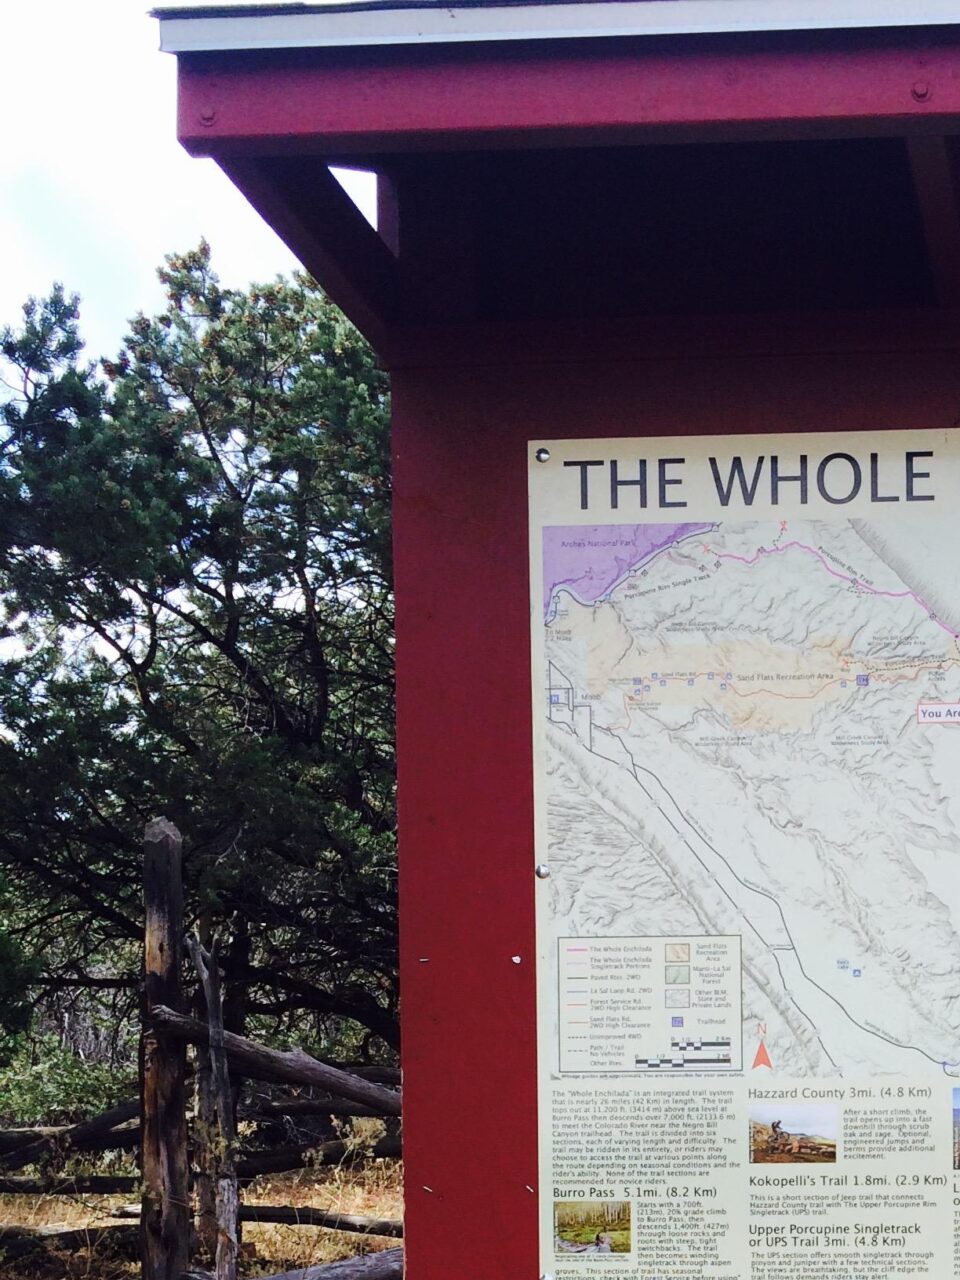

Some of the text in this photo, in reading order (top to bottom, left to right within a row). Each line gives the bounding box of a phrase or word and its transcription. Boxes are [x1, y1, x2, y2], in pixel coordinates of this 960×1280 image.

[563, 457, 688, 510] THE
[708, 451, 935, 507] WHOLE
[921, 709, 943, 719] You
[757, 1023, 767, 1035] N
[748, 1087, 932, 1101] Hazzard County 3mi. (4.8 Km)
[842, 1122, 930, 1132] downhill through scrub
[551, 1161, 564, 1169] the
[565, 1161, 585, 1169] route
[586, 1161, 627, 1171] depending
[639, 1161, 671, 1169] seasonal
[671, 1160, 712, 1169] conditions
[712, 1160, 727, 1169] and
[728, 1160, 741, 1169] the
[551, 1176, 667, 1185] recommended for novice riders.
[749, 1174, 948, 1189] Kokopelli's Trail 1.8mi. (2.9 Km)
[552, 1187, 717, 1200] Burro Pass 5.1mi. (8.2 Km)
[748, 1200, 937, 1210] Hazzard County trail with The Upper Porcupine Rim
[748, 1223, 921, 1237] Upper Porcupine Singletrack
[748, 1236, 906, 1250] or UPS Trail 3mi. (4.8 Km)
[636, 1251, 654, 1259] then
[654, 1251, 688, 1259] becomes
[688, 1251, 720, 1261] winding
[751, 1250, 934, 1260] The UPS section offers smooth singletrack through
[636, 1258, 677, 1268] singletrack
[678, 1258, 709, 1268] through
[709, 1259, 732, 1268] aspen
